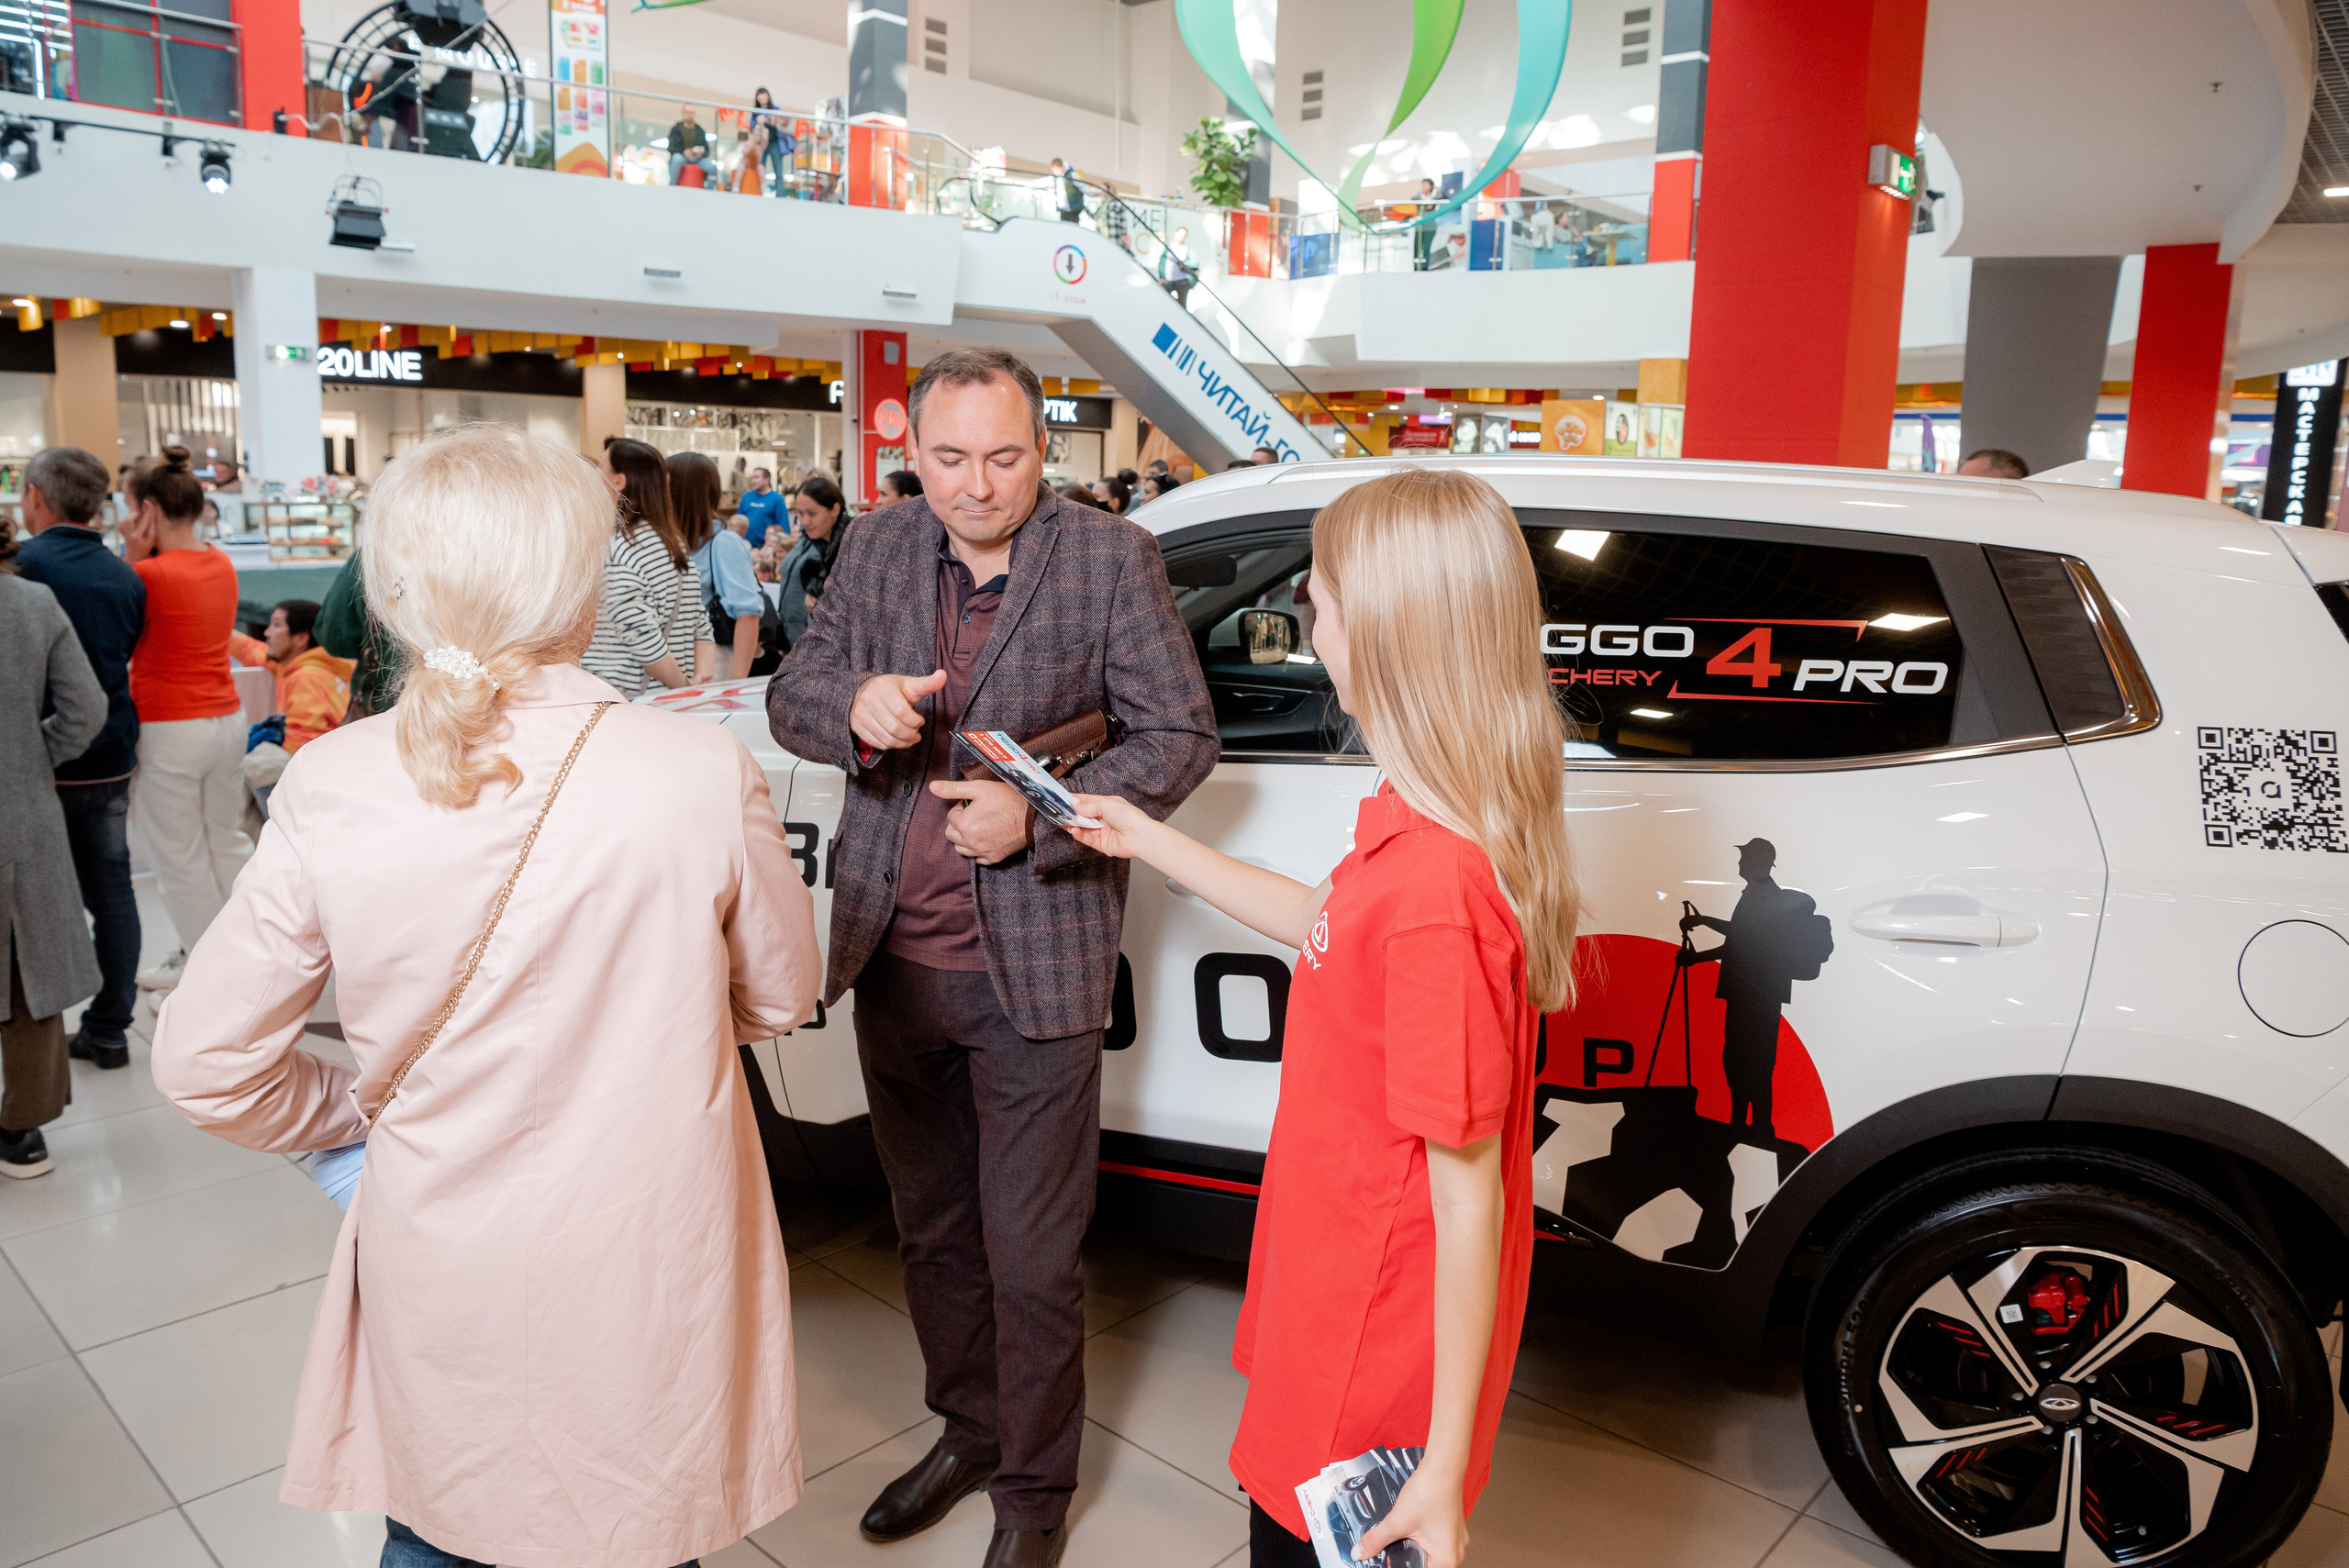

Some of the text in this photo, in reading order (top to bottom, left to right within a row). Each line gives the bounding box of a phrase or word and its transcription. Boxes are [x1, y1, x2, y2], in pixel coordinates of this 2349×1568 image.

[317, 347, 423, 381] 20LINE
[1539, 623, 1949, 695] GGO 4 PRO
[1547, 667, 1663, 687] CHERY
[1018, 752, 1030, 762] 4
[1302, 1488, 1316, 1517] CHERY
